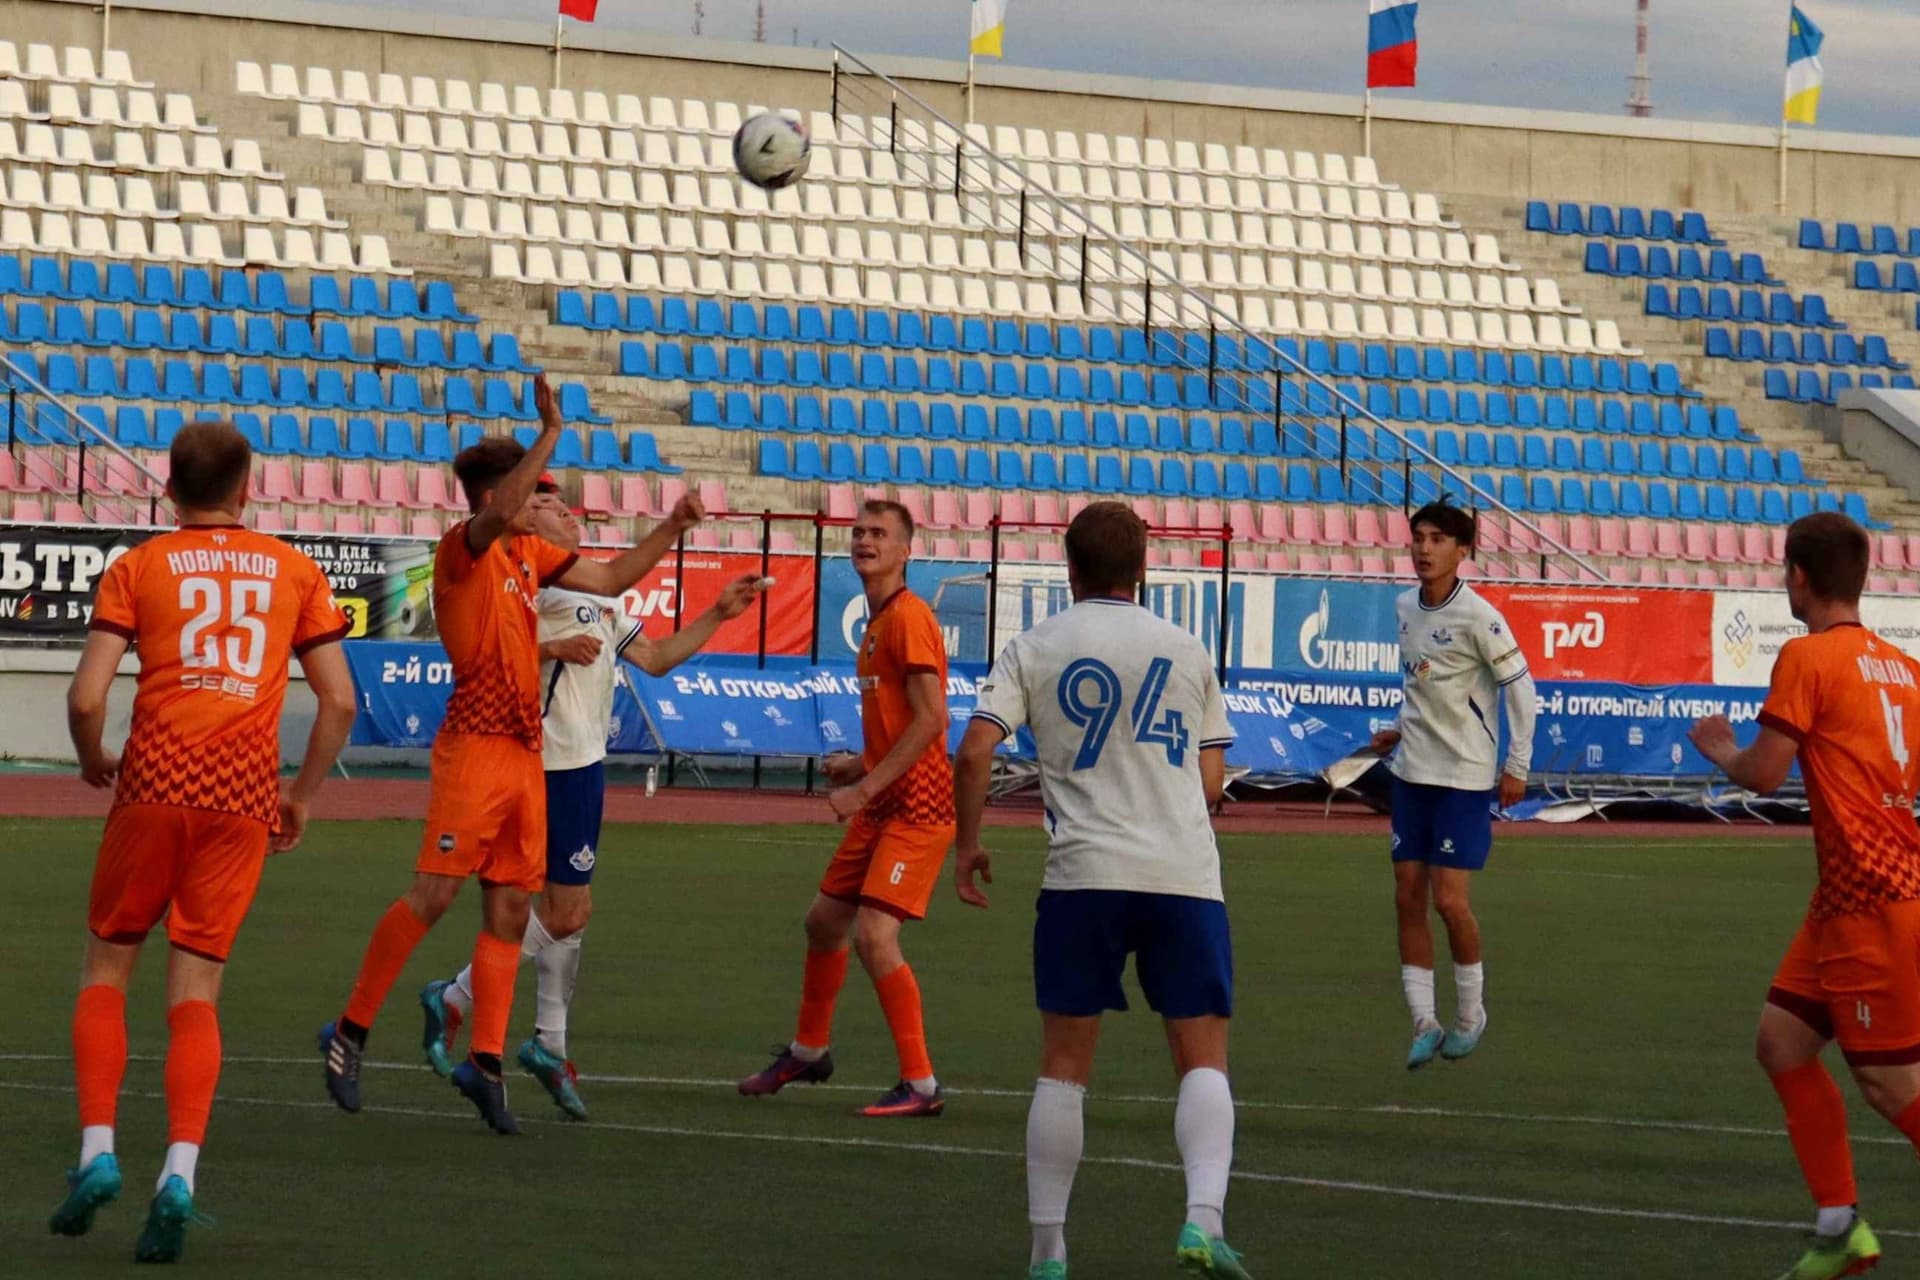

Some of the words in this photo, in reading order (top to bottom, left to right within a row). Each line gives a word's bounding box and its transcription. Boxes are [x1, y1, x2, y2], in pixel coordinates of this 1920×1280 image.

[166, 550, 278, 579] НОВИЧКОВ
[290, 543, 335, 560] АСЛА
[339, 545, 370, 561] ДЛЯ
[328, 575, 357, 590] ВТО
[179, 576, 272, 678] 25
[1326, 640, 1400, 672] ГАЗПРОМ
[382, 656, 421, 684] 2-Й
[673, 672, 719, 696] 2-Й
[1057, 657, 1189, 772] 94
[1224, 694, 1268, 714] БОК
[1567, 694, 1665, 718] ОТКРЫТЫЙ
[1669, 699, 1725, 719] КУБОК
[890, 862, 905, 885] 6
[1857, 1000, 1871, 1029] 4
